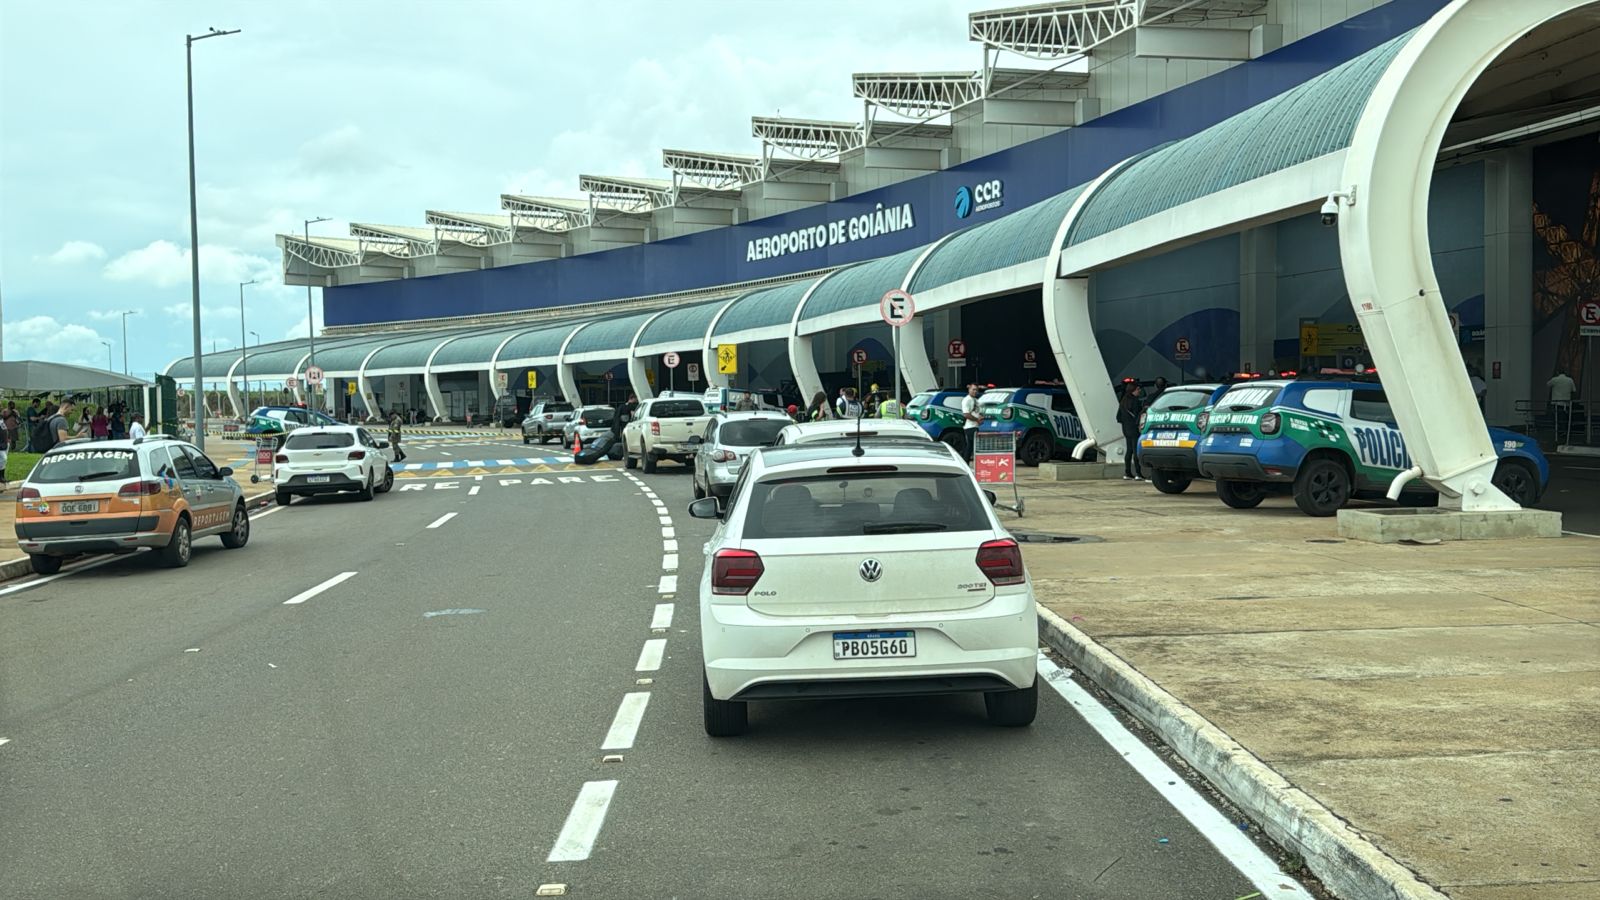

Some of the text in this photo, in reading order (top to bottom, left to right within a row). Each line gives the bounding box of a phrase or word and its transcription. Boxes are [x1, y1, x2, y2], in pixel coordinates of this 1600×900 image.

[975, 179, 1001, 203] CCR
[746, 203, 914, 262] AEROPORTO DE GOIÂNIA
[1503, 440, 1517, 448] 190
[42, 451, 134, 465] REPORTAGEM
[399, 481, 460, 492] RE
[499, 475, 621, 487] PARE
[193, 511, 230, 527] REPORTAGEM
